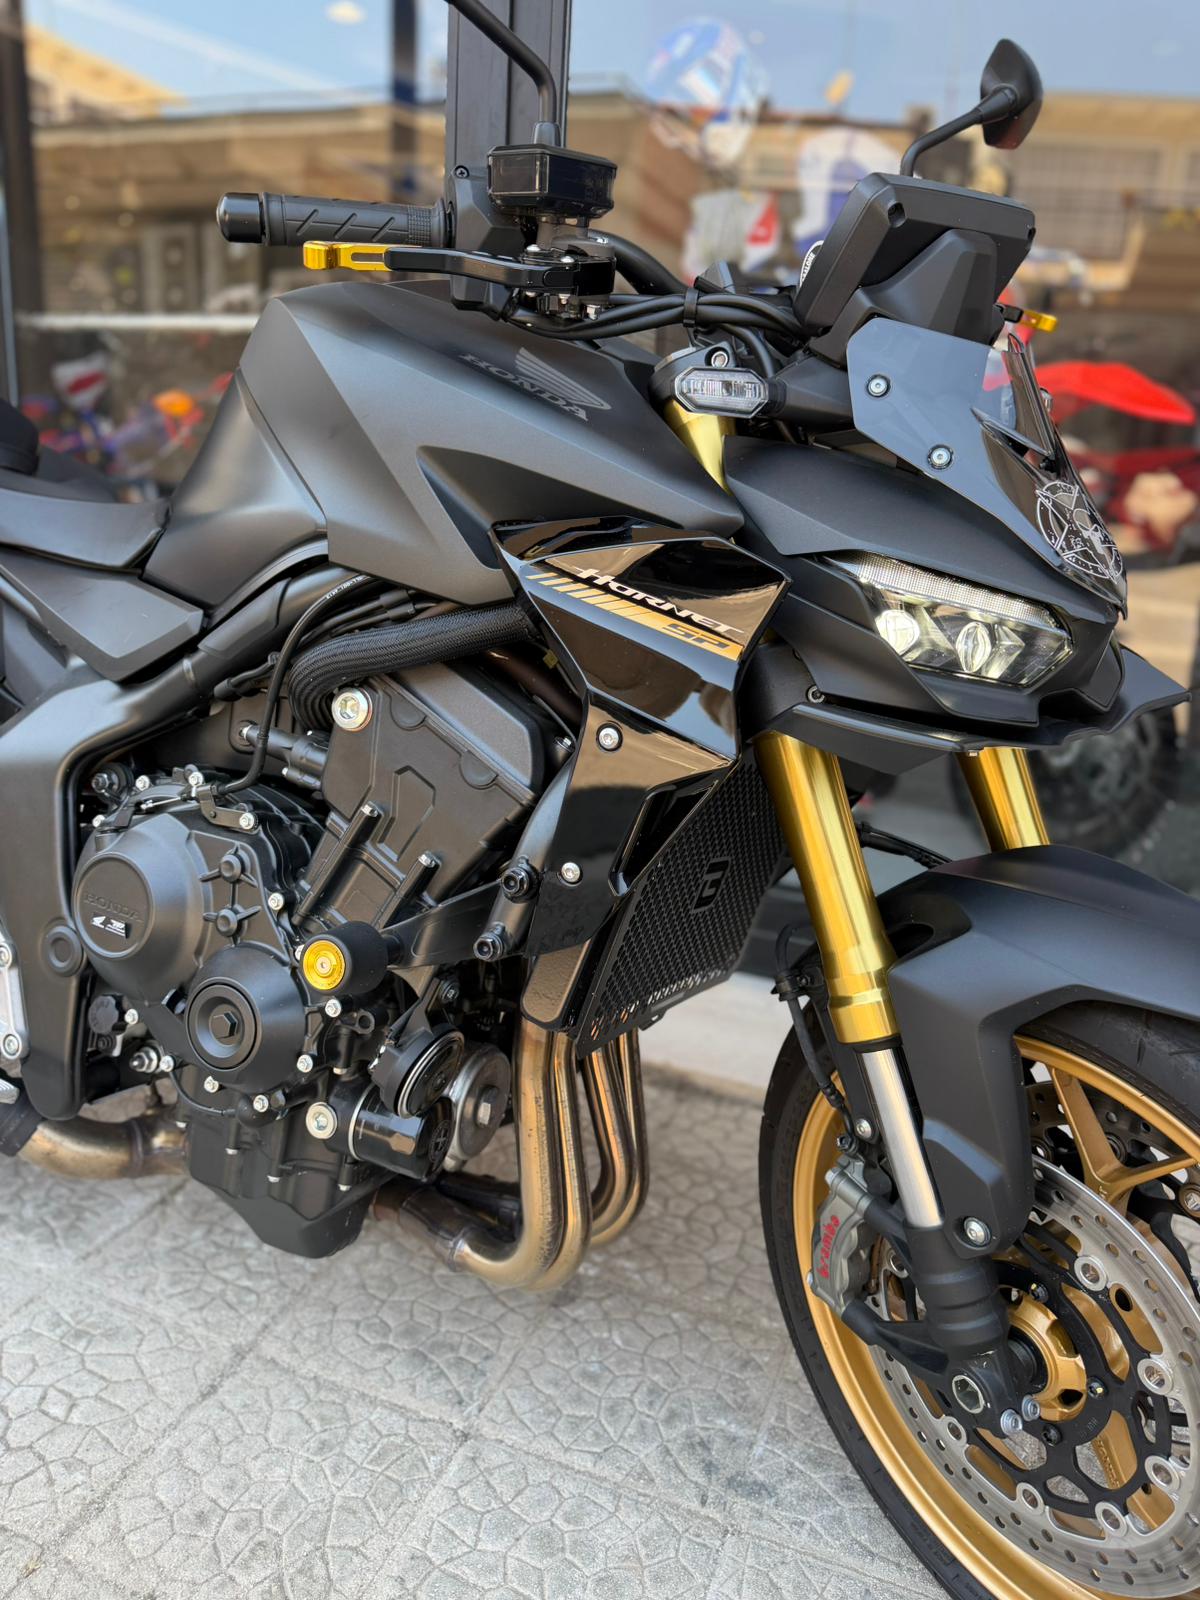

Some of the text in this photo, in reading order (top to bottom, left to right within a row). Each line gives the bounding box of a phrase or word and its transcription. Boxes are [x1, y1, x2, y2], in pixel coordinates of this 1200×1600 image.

[458, 353, 589, 422] HONDA
[661, 623, 731, 649] SP
[83, 893, 144, 923] HONDA
[816, 1214, 840, 1279] brembo
